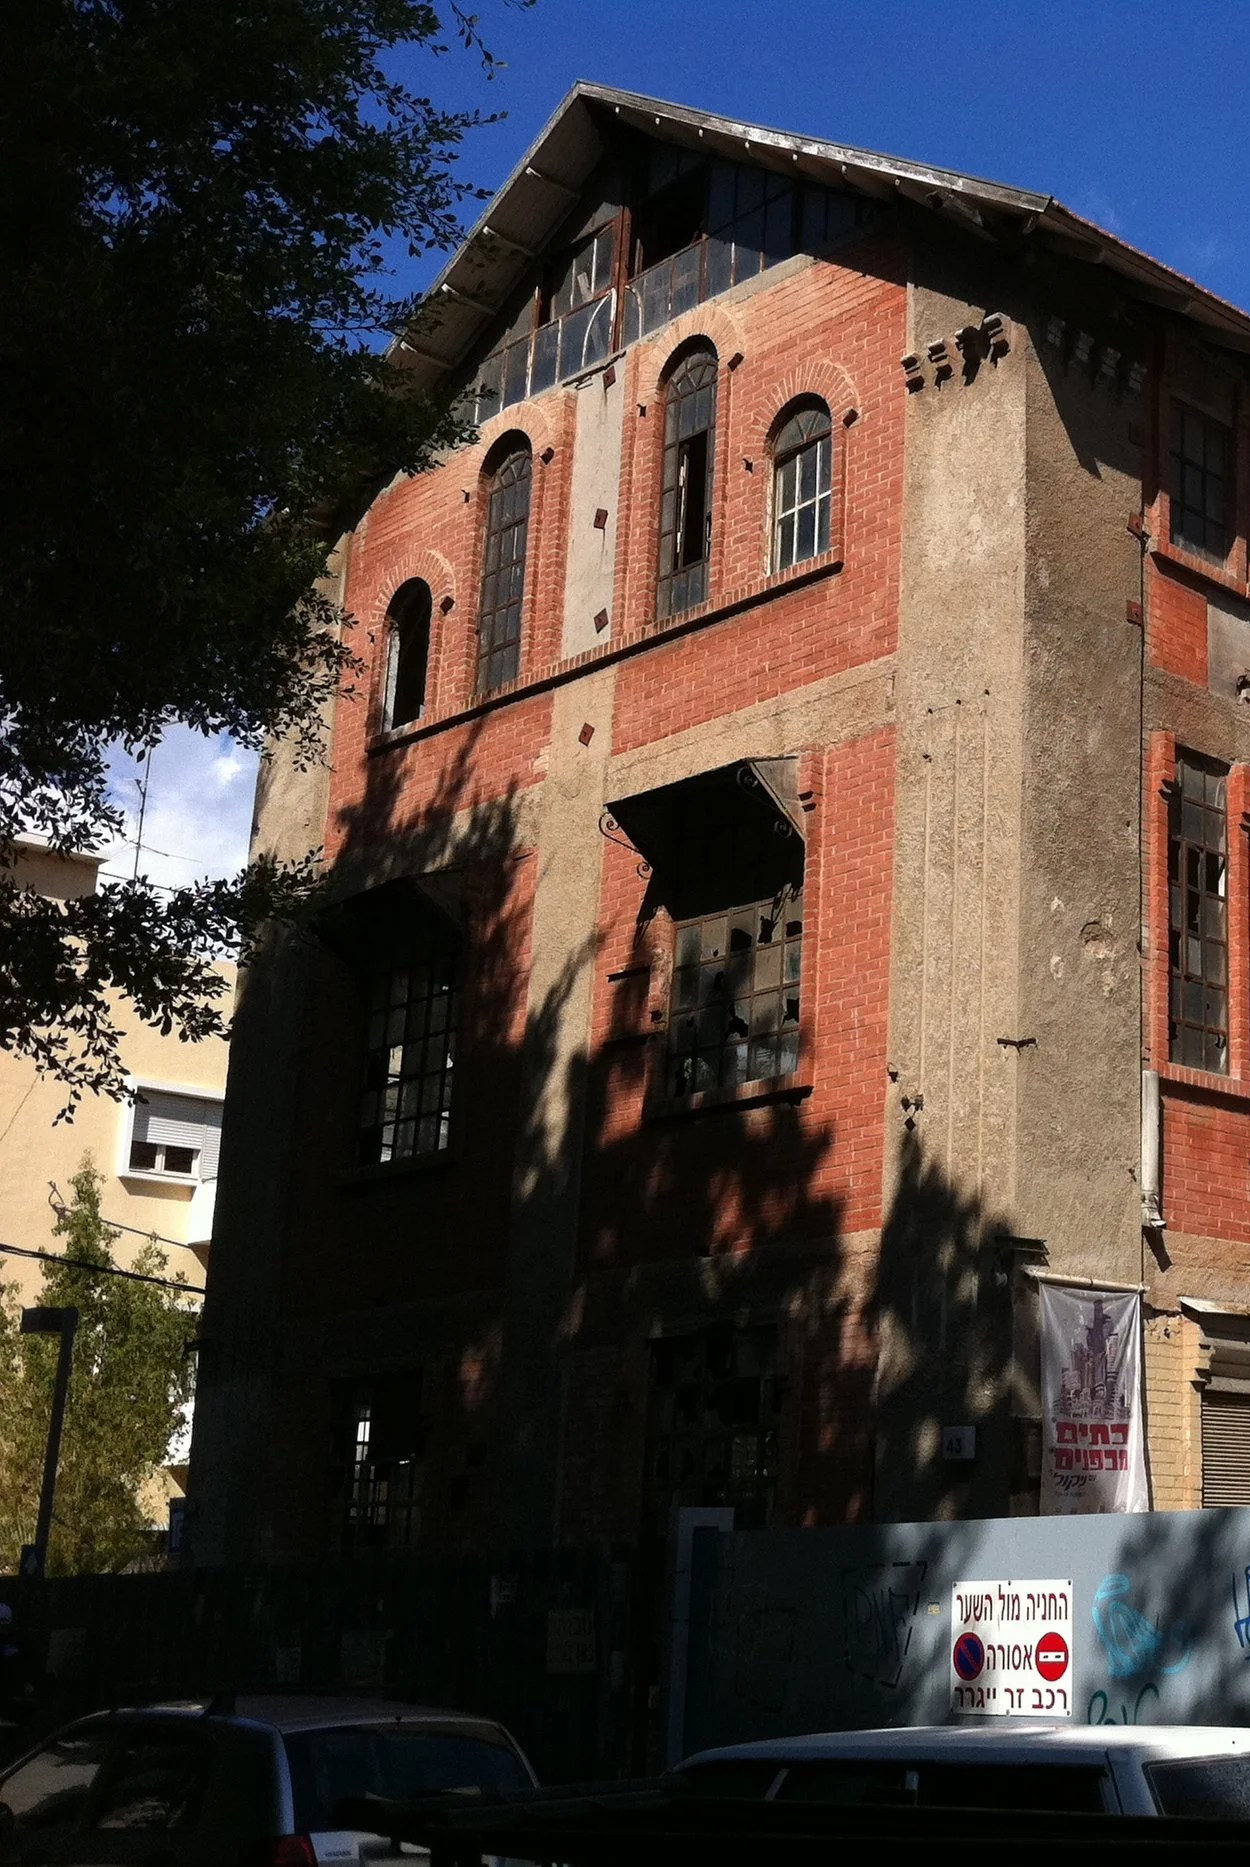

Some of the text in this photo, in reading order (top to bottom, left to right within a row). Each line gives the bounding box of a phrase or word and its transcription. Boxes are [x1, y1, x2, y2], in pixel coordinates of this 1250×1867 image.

[956, 1584, 1068, 1624] החניה מול השער
[986, 1644, 1033, 1670] אסורה
[954, 1687, 997, 1709] ייגרר
[1004, 1688, 1024, 1709] זר
[1031, 1688, 1068, 1709] רכב
